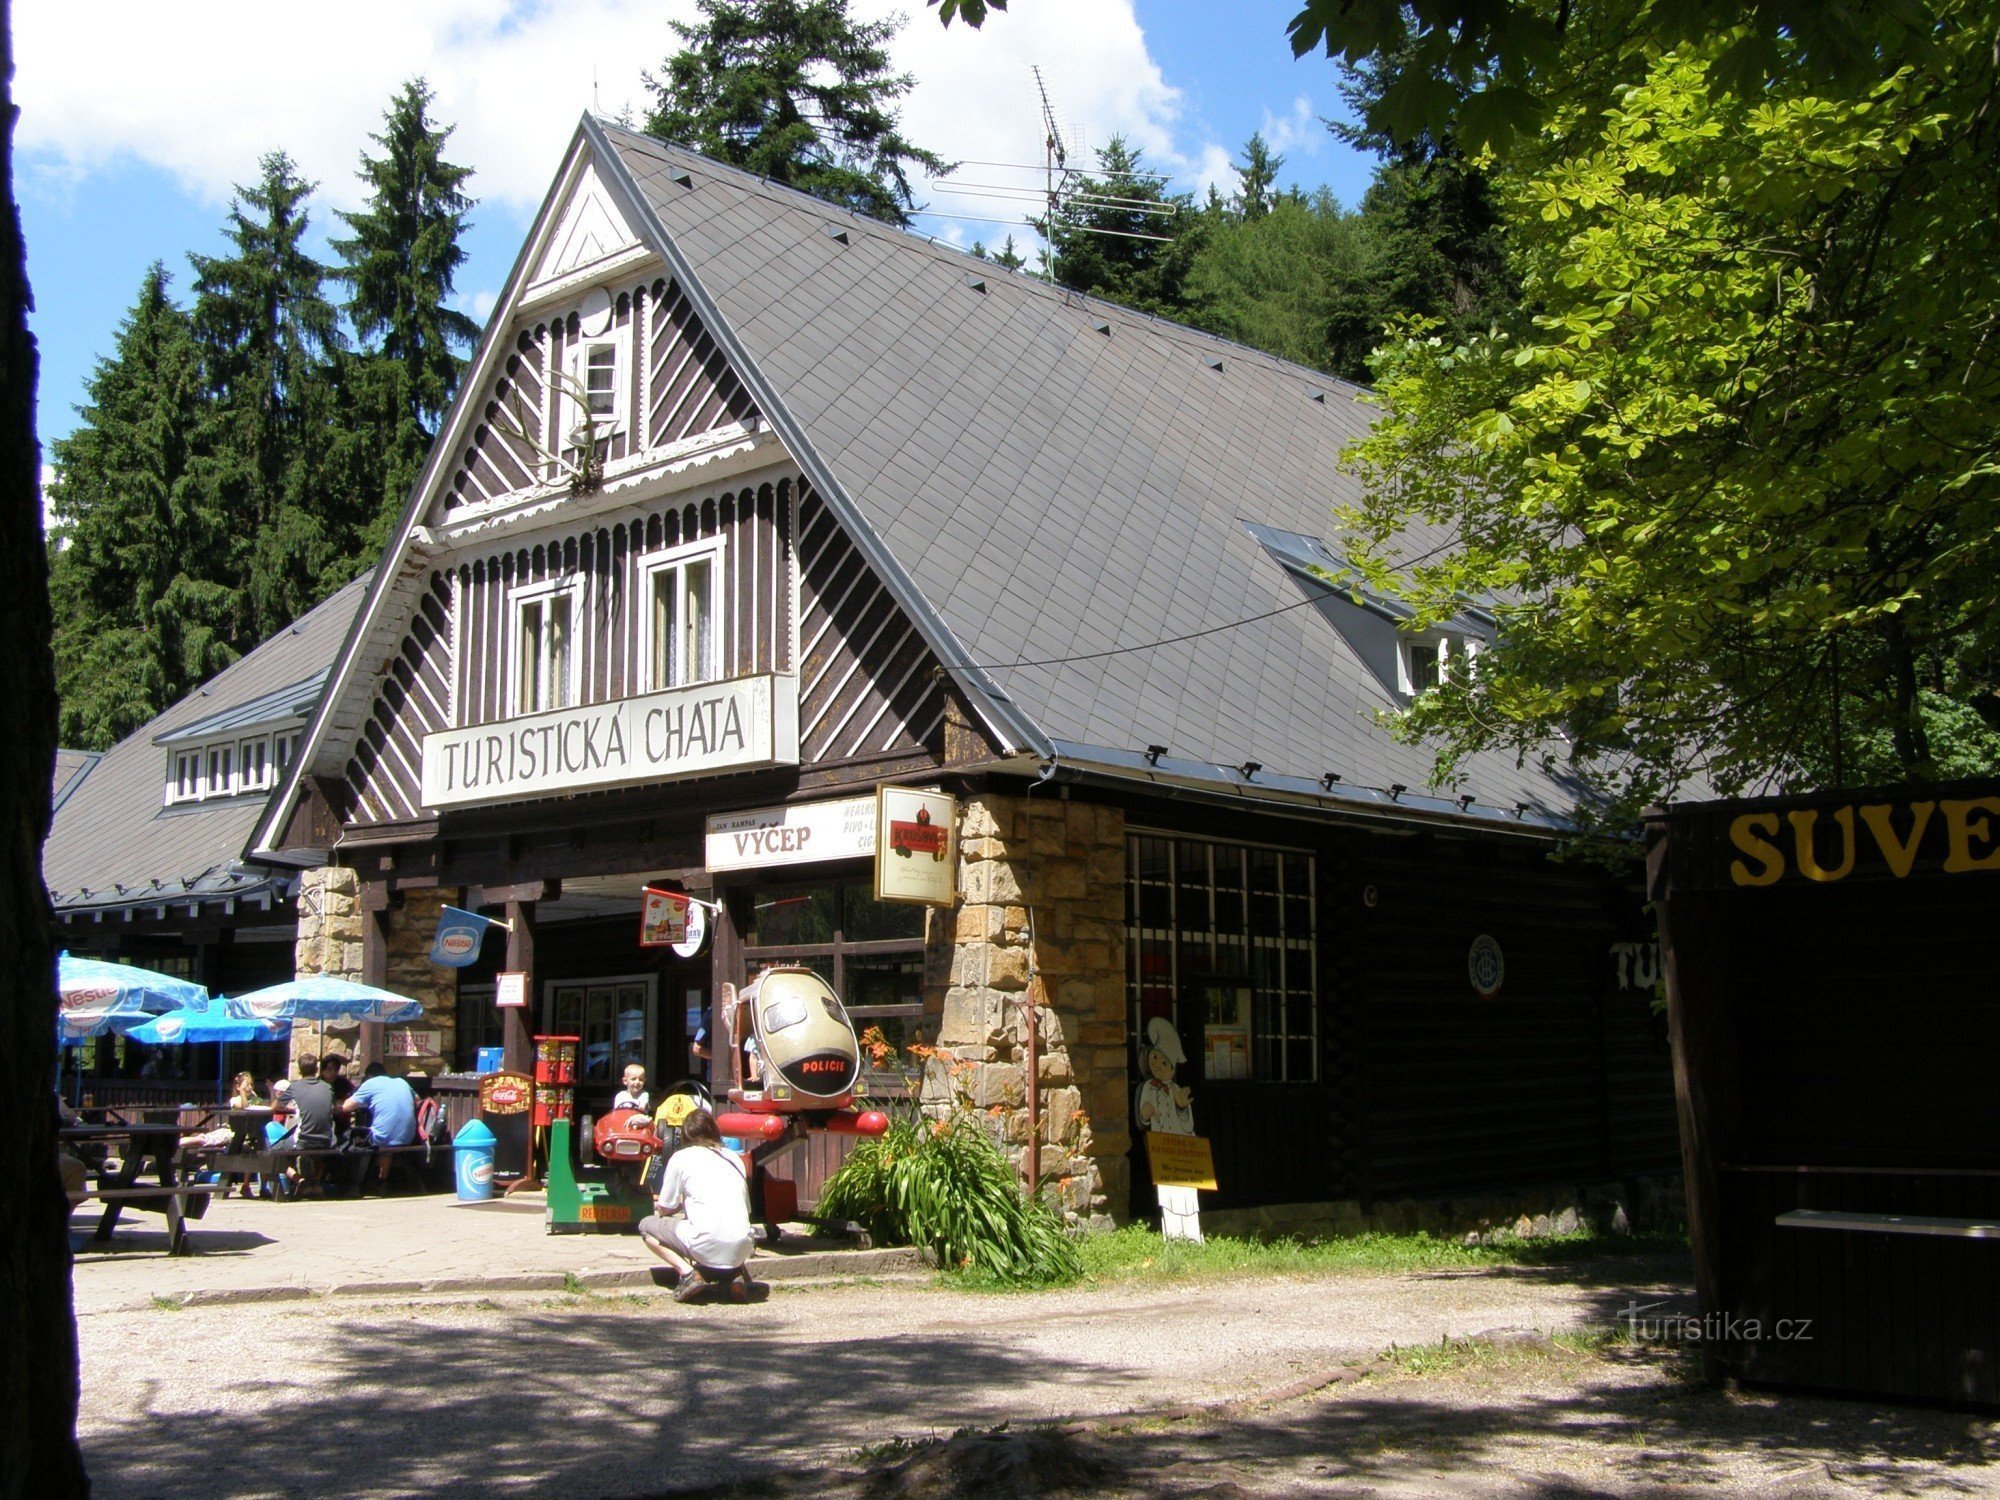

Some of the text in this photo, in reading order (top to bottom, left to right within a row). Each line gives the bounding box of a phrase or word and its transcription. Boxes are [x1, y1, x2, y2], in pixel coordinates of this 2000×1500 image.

[443, 694, 746, 792] TURISTICKÁ CHATA
[733, 821, 811, 857] VÝČEP
[894, 828, 948, 844] KRUŠOVI
[1729, 797, 2000, 887] SUVE
[1608, 941, 1665, 992] TU
[802, 1060, 845, 1073] POLICIE
